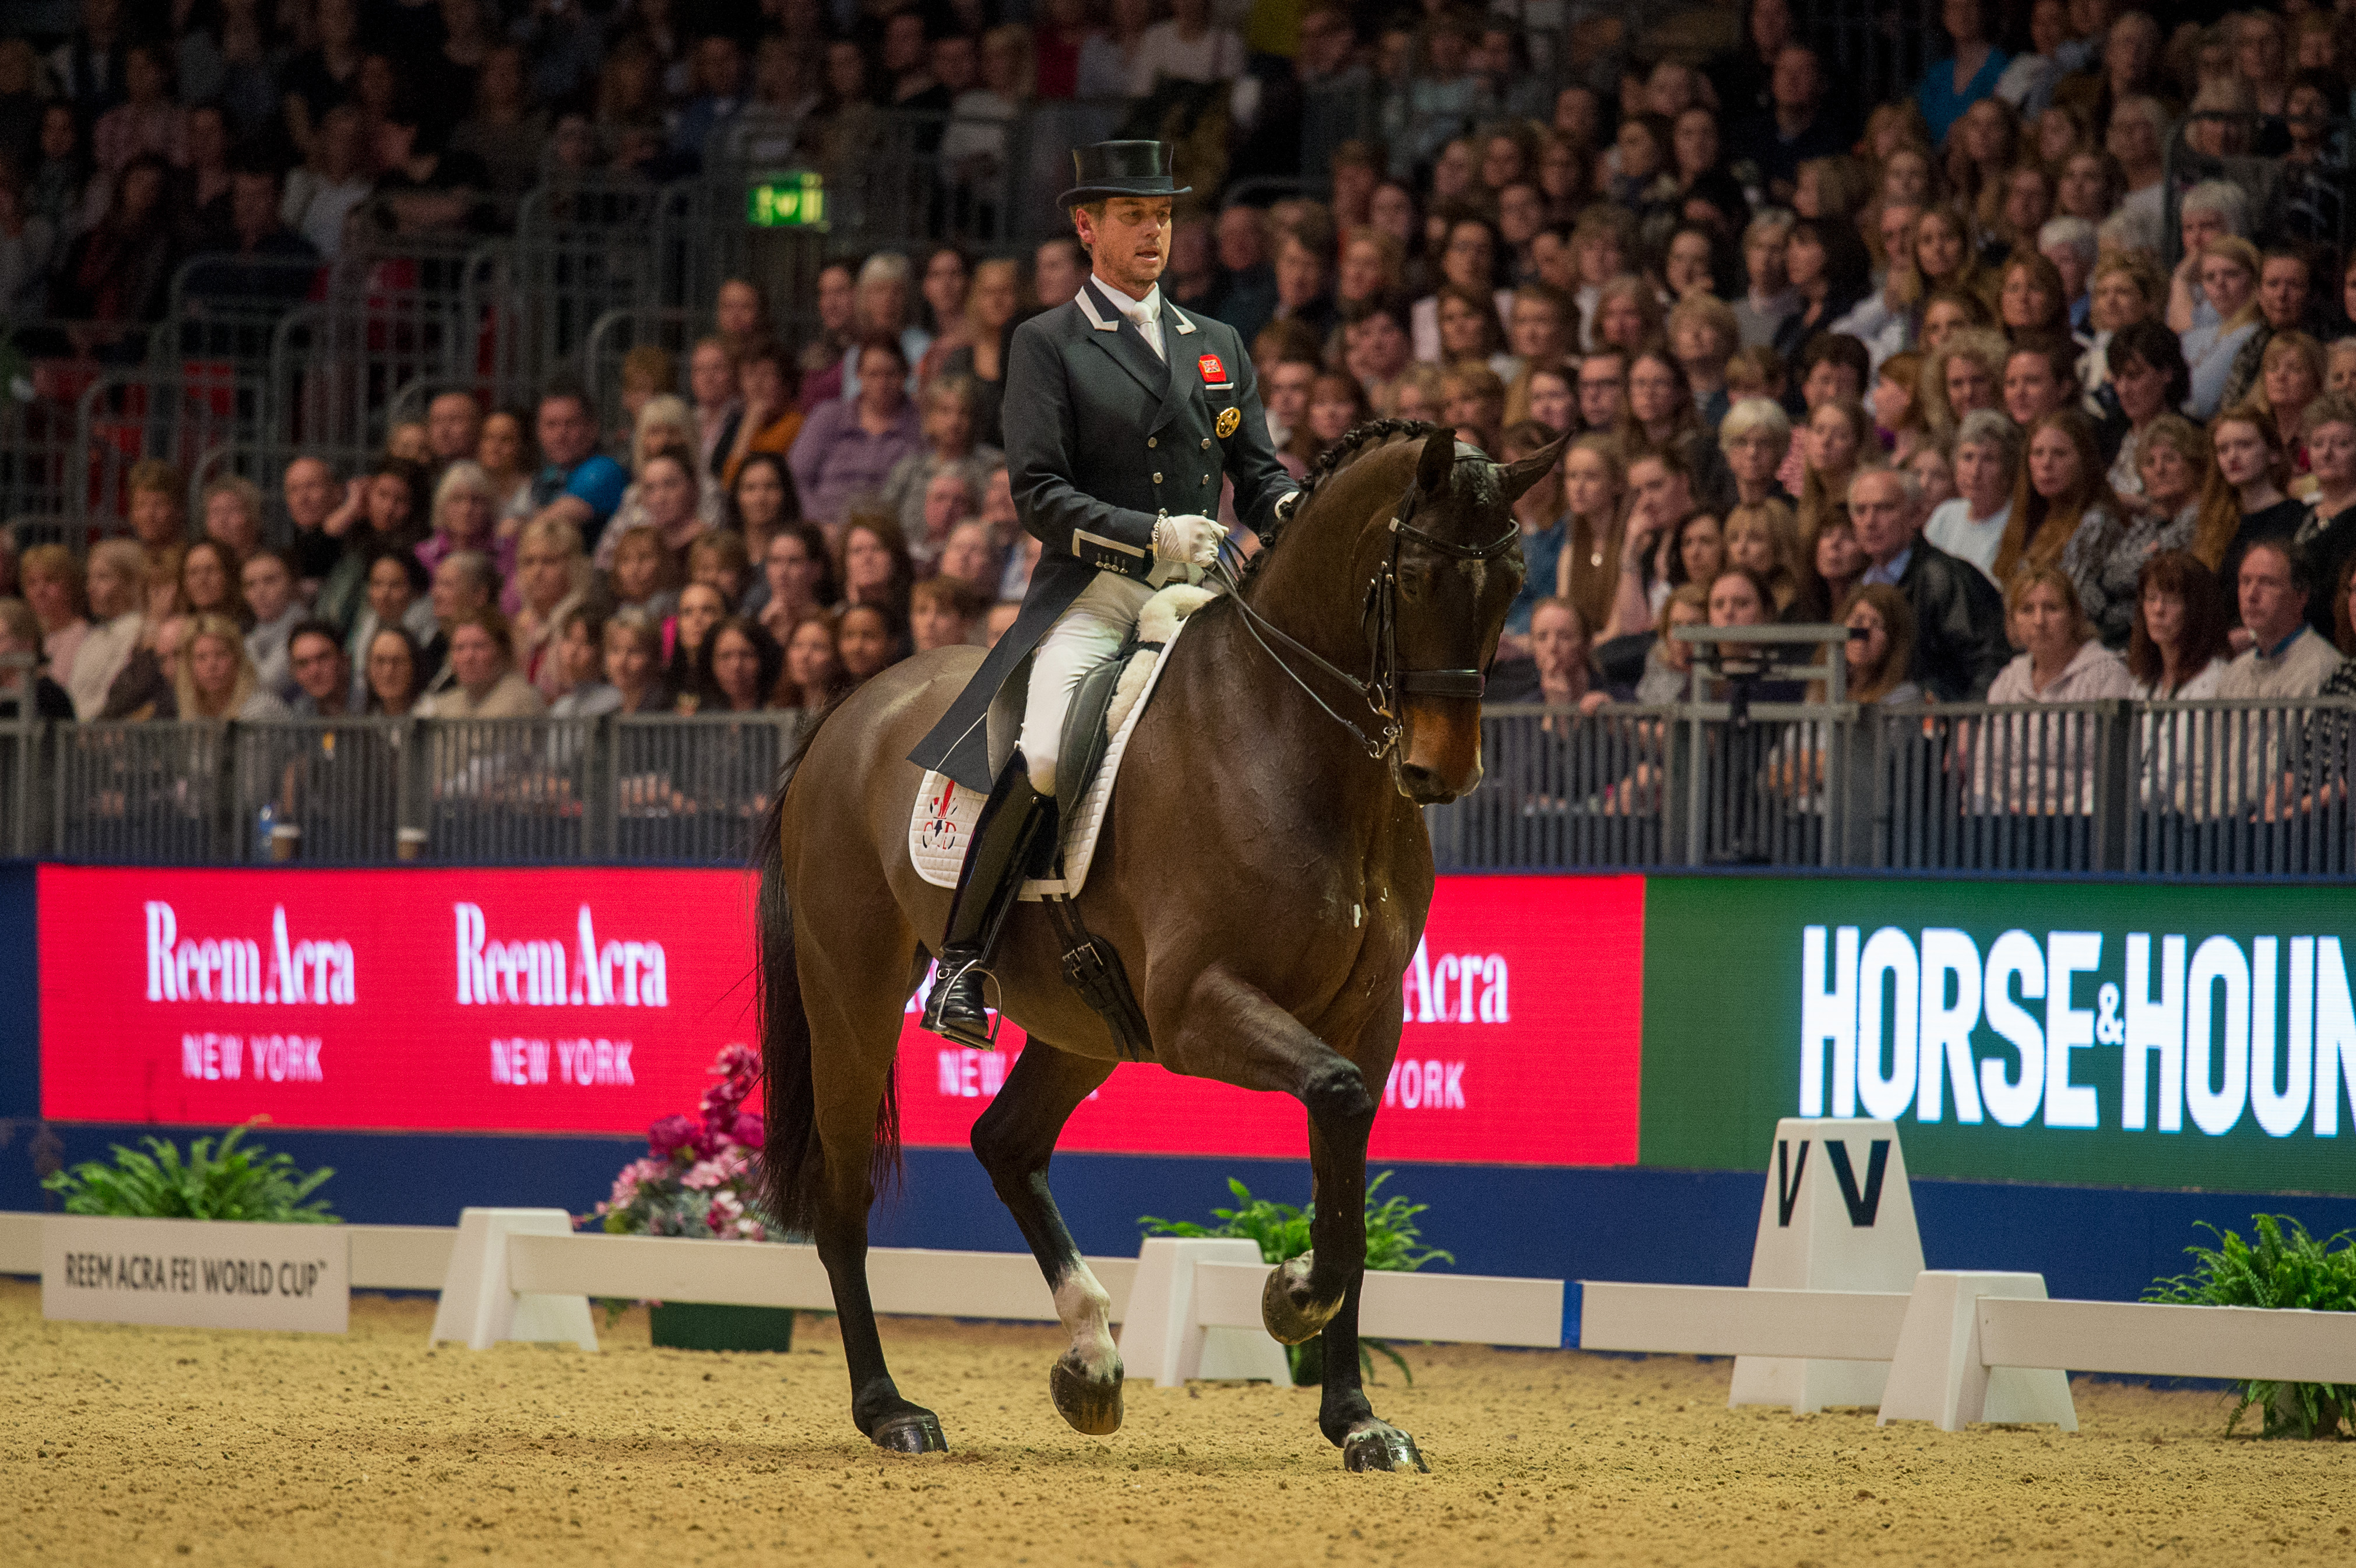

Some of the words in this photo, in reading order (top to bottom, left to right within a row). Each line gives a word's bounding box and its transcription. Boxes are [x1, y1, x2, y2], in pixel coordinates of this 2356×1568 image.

[145, 901, 262, 1004] Reem
[263, 903, 355, 1005] Acra
[454, 902, 568, 1006] Reem
[569, 903, 669, 1007] Acra
[1403, 933, 1510, 1024] Acra
[182, 1032, 244, 1081] NEW
[251, 1034, 323, 1082] YORK
[490, 1038, 551, 1085] NEW
[557, 1038, 635, 1087] YORK
[1799, 926, 2102, 1129] HORSE
[938, 1050, 1006, 1097] NEW
[1779, 1140, 1810, 1227] V
[1824, 1140, 1891, 1227] V
[65, 1251, 112, 1289] REEM
[116, 1254, 167, 1292] ACRA
[171, 1257, 197, 1293] FEI
[201, 1257, 274, 1296] WORLD
